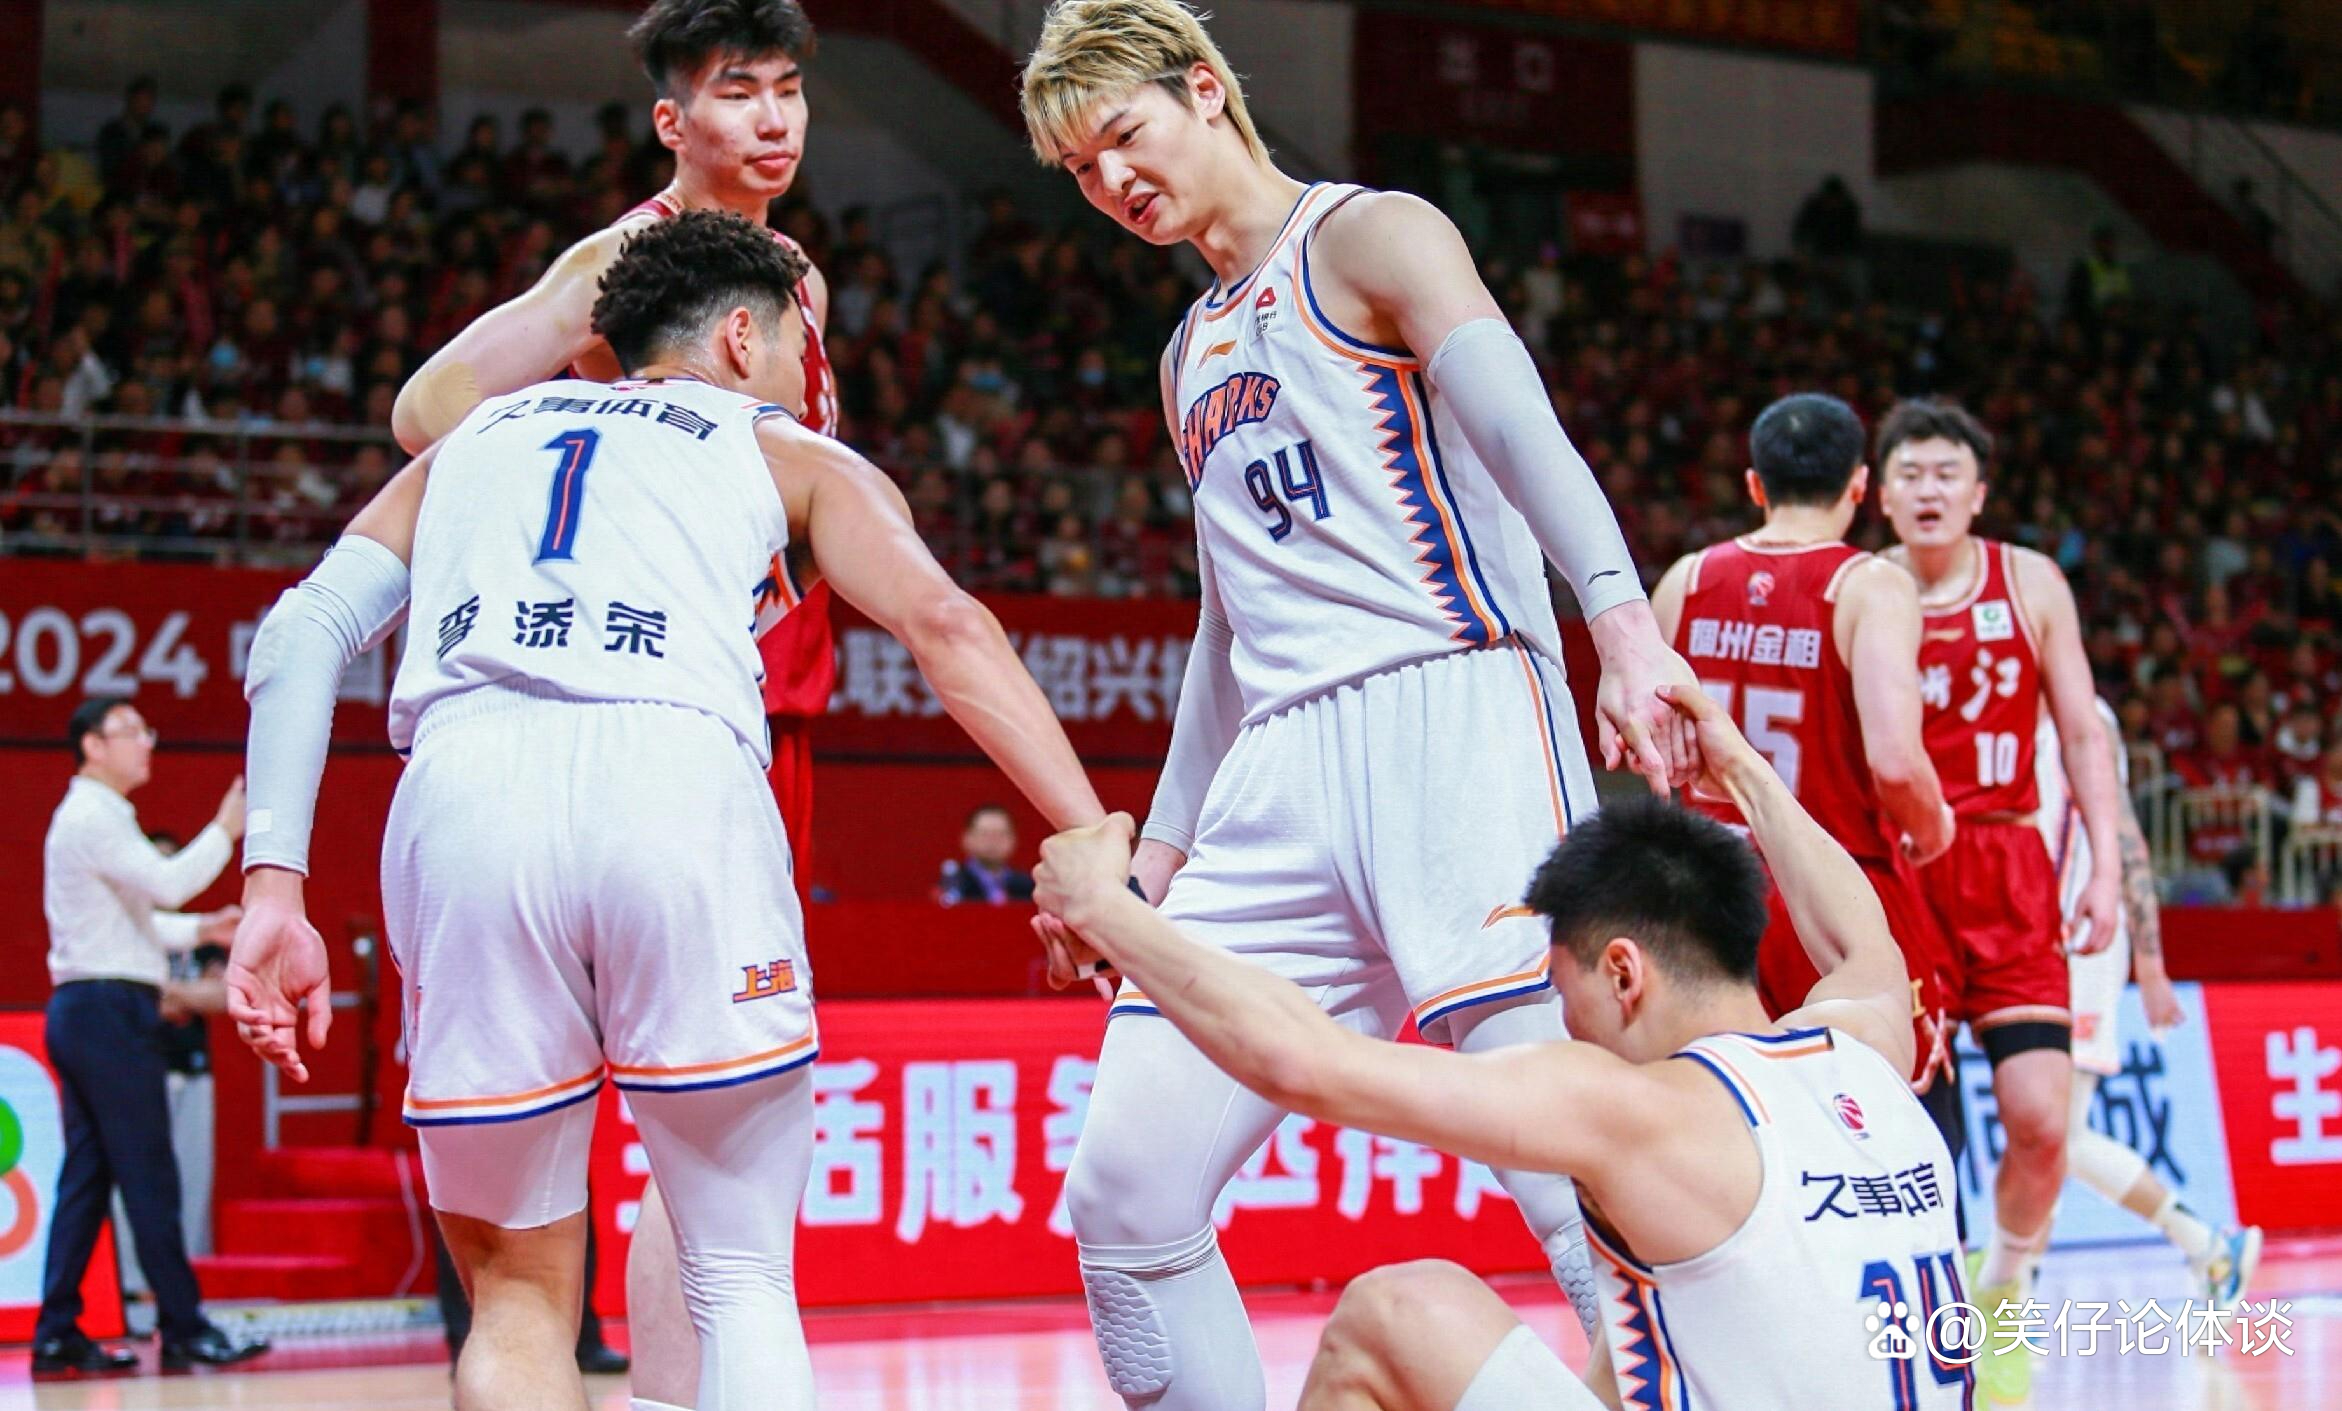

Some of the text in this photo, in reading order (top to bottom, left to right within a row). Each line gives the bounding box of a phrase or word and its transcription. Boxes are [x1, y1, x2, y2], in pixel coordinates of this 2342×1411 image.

[477, 396, 718, 441] 久事体育
[1183, 372, 1281, 494] HARKS
[531, 425, 603, 567] 1
[1245, 440, 1333, 543] 94
[0, 605, 207, 698] 024
[436, 594, 667, 661] 李添荣
[1975, 731, 2019, 787] 10
[733, 959, 797, 1003] 上海
